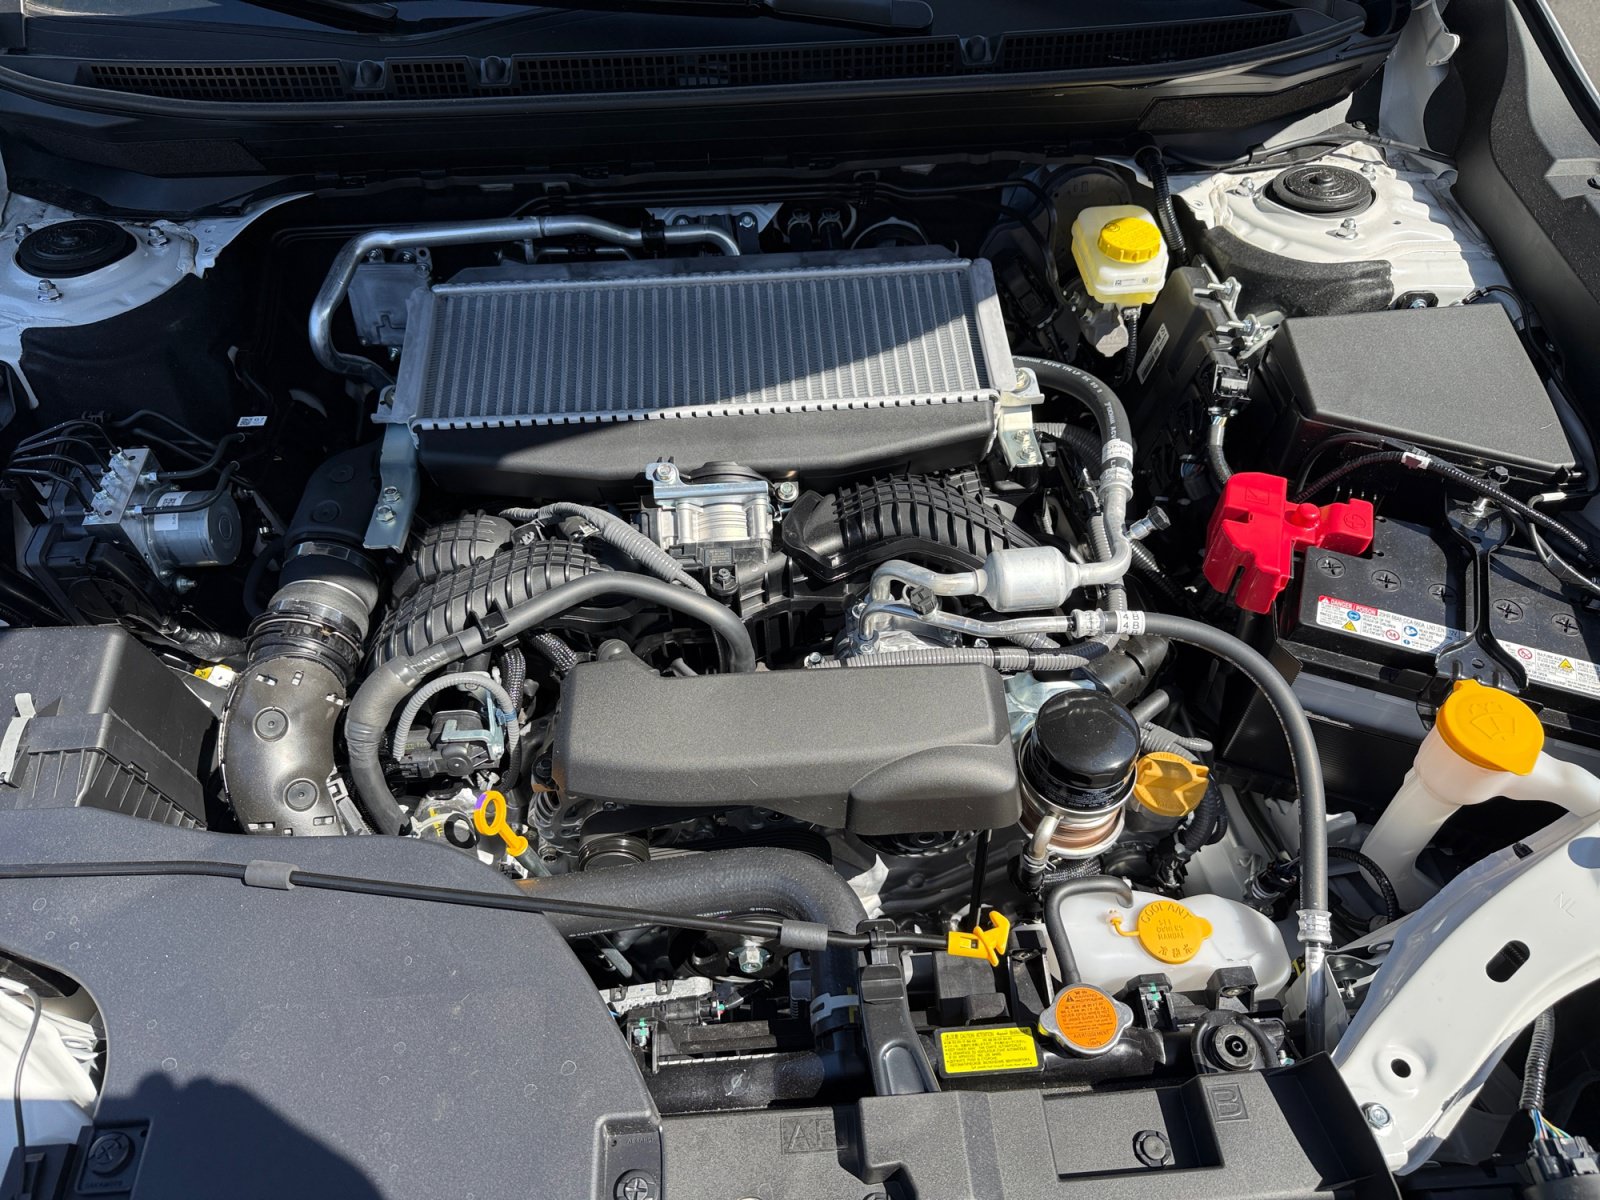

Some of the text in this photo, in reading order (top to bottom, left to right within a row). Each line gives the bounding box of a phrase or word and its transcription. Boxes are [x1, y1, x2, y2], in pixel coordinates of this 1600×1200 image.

[1330, 598, 1353, 610] DANGER
[1355, 604, 1377, 615] POISON
[1141, 902, 1192, 924] COOLANT
